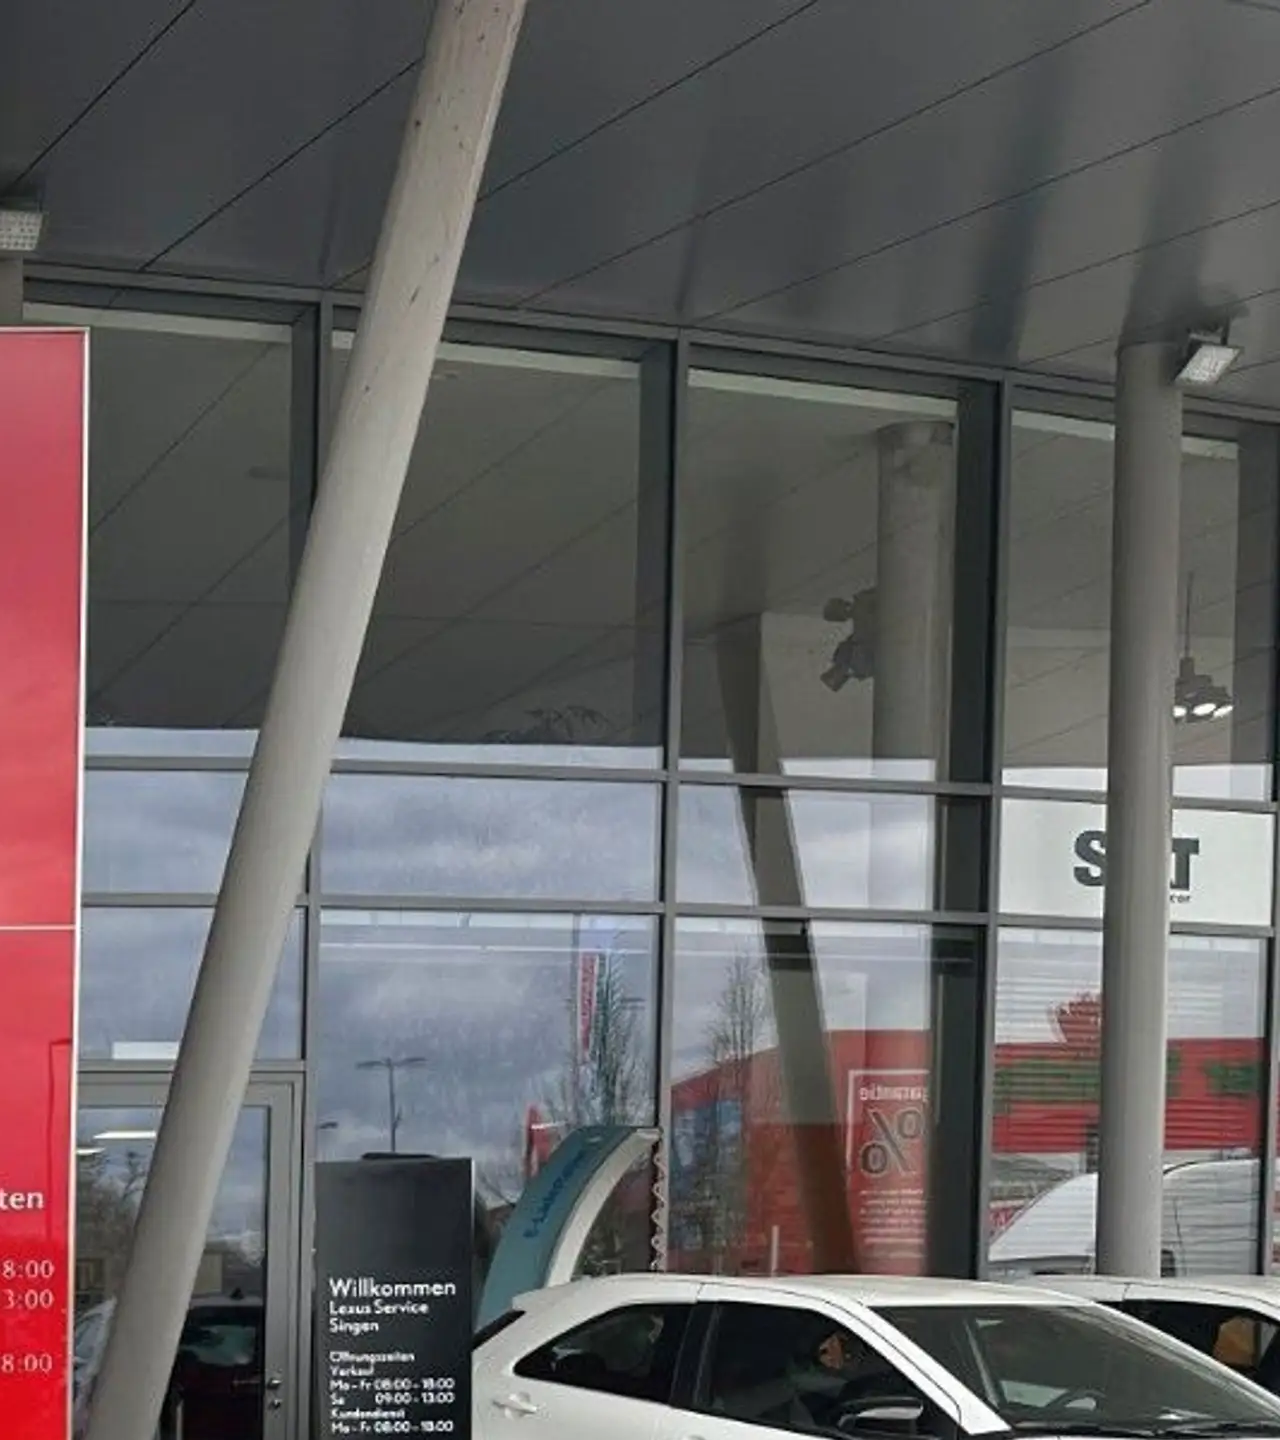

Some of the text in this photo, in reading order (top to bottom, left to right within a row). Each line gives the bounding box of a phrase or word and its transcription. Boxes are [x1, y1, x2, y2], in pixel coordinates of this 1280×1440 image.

[329, 1276, 457, 1298] Willkommen
[329, 1299, 430, 1315] Lexus Service
[329, 1317, 380, 1336] Singen
